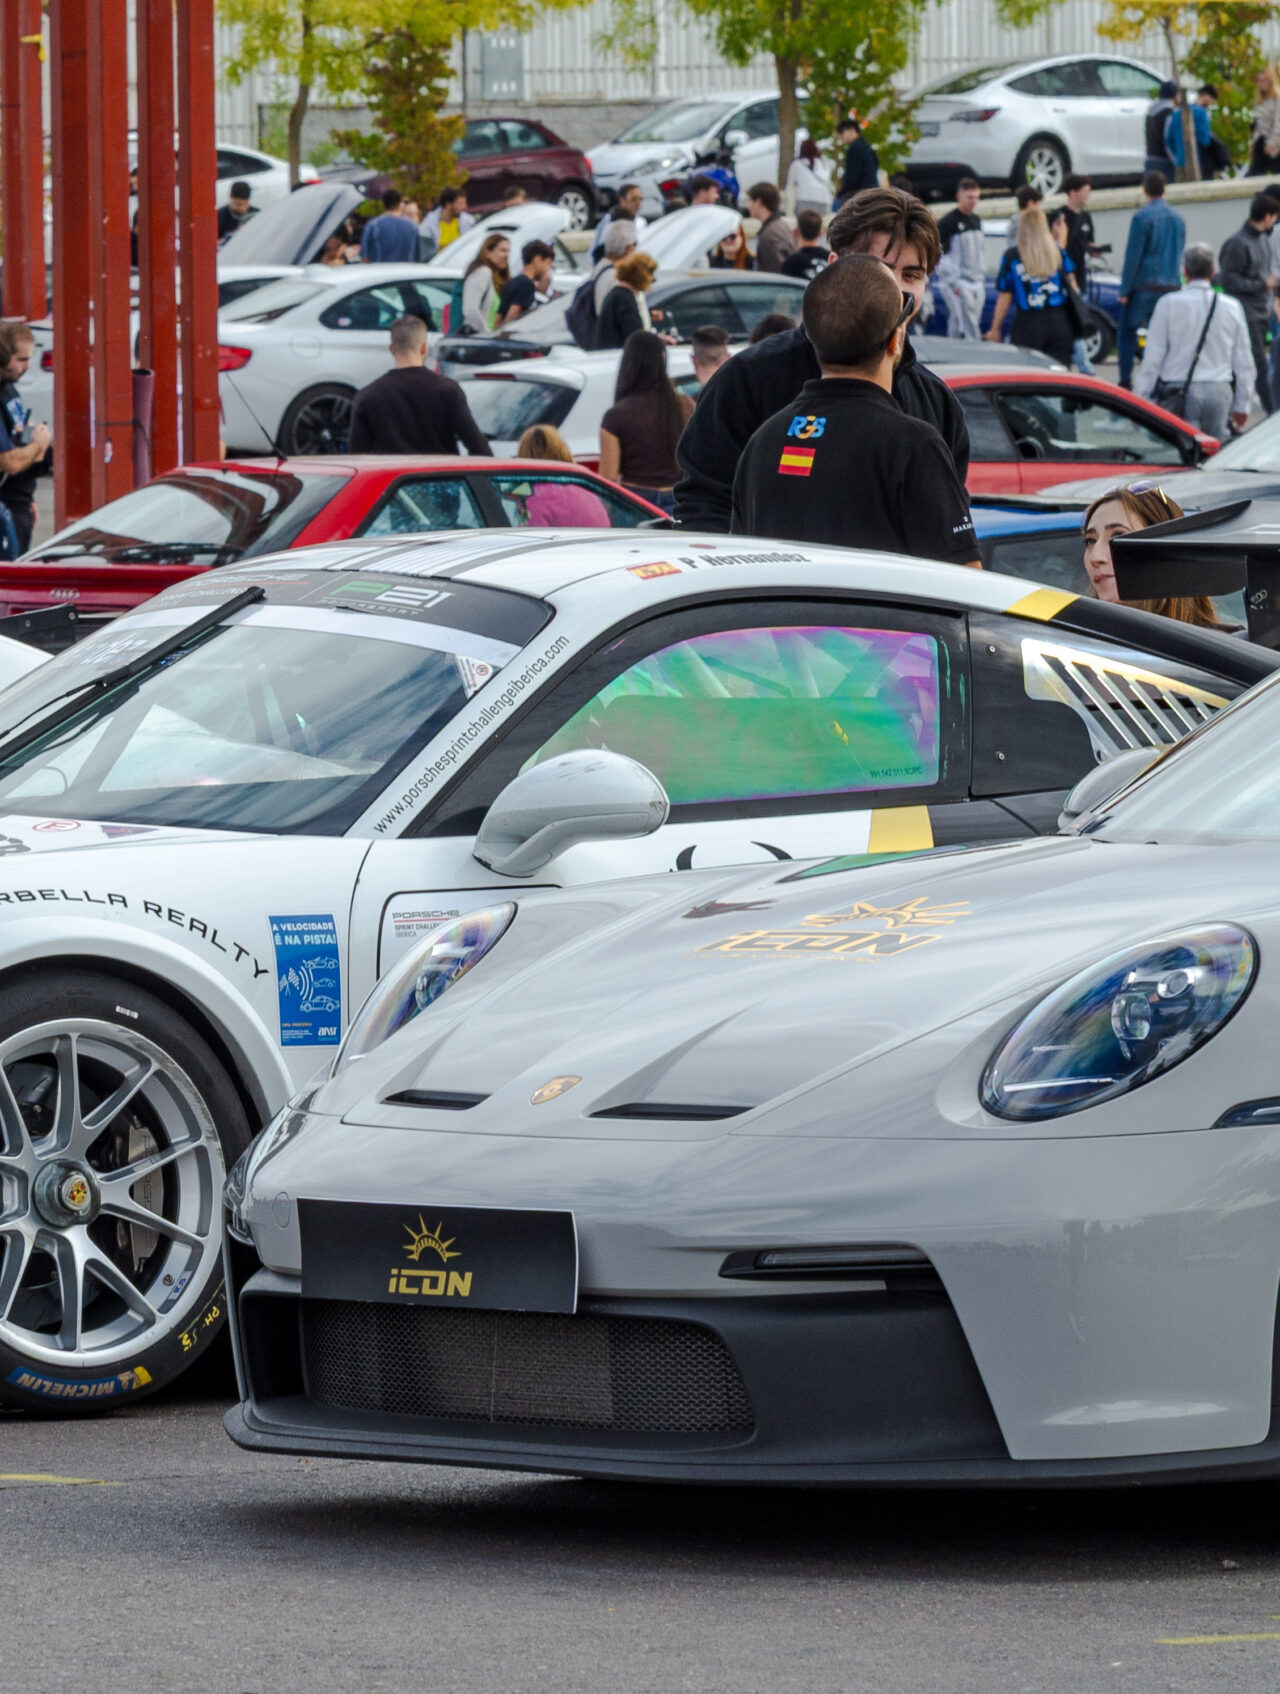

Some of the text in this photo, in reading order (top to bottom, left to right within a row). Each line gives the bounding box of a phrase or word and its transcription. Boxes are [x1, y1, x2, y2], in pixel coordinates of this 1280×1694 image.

[787, 415, 827, 439] RGB
[698, 551, 812, 567] Hernandez
[373, 634, 570, 834] www.porschesprintchallengeiberica.com
[392, 910, 459, 919] PORSCHE
[272, 922, 334, 931] A VELOCIDADE
[394, 923, 415, 931] SPRINT
[142, 899, 270, 980] REALTY
[274, 932, 337, 945] É NA PISTA!
[16, 1372, 116, 1397] MICHELIN
